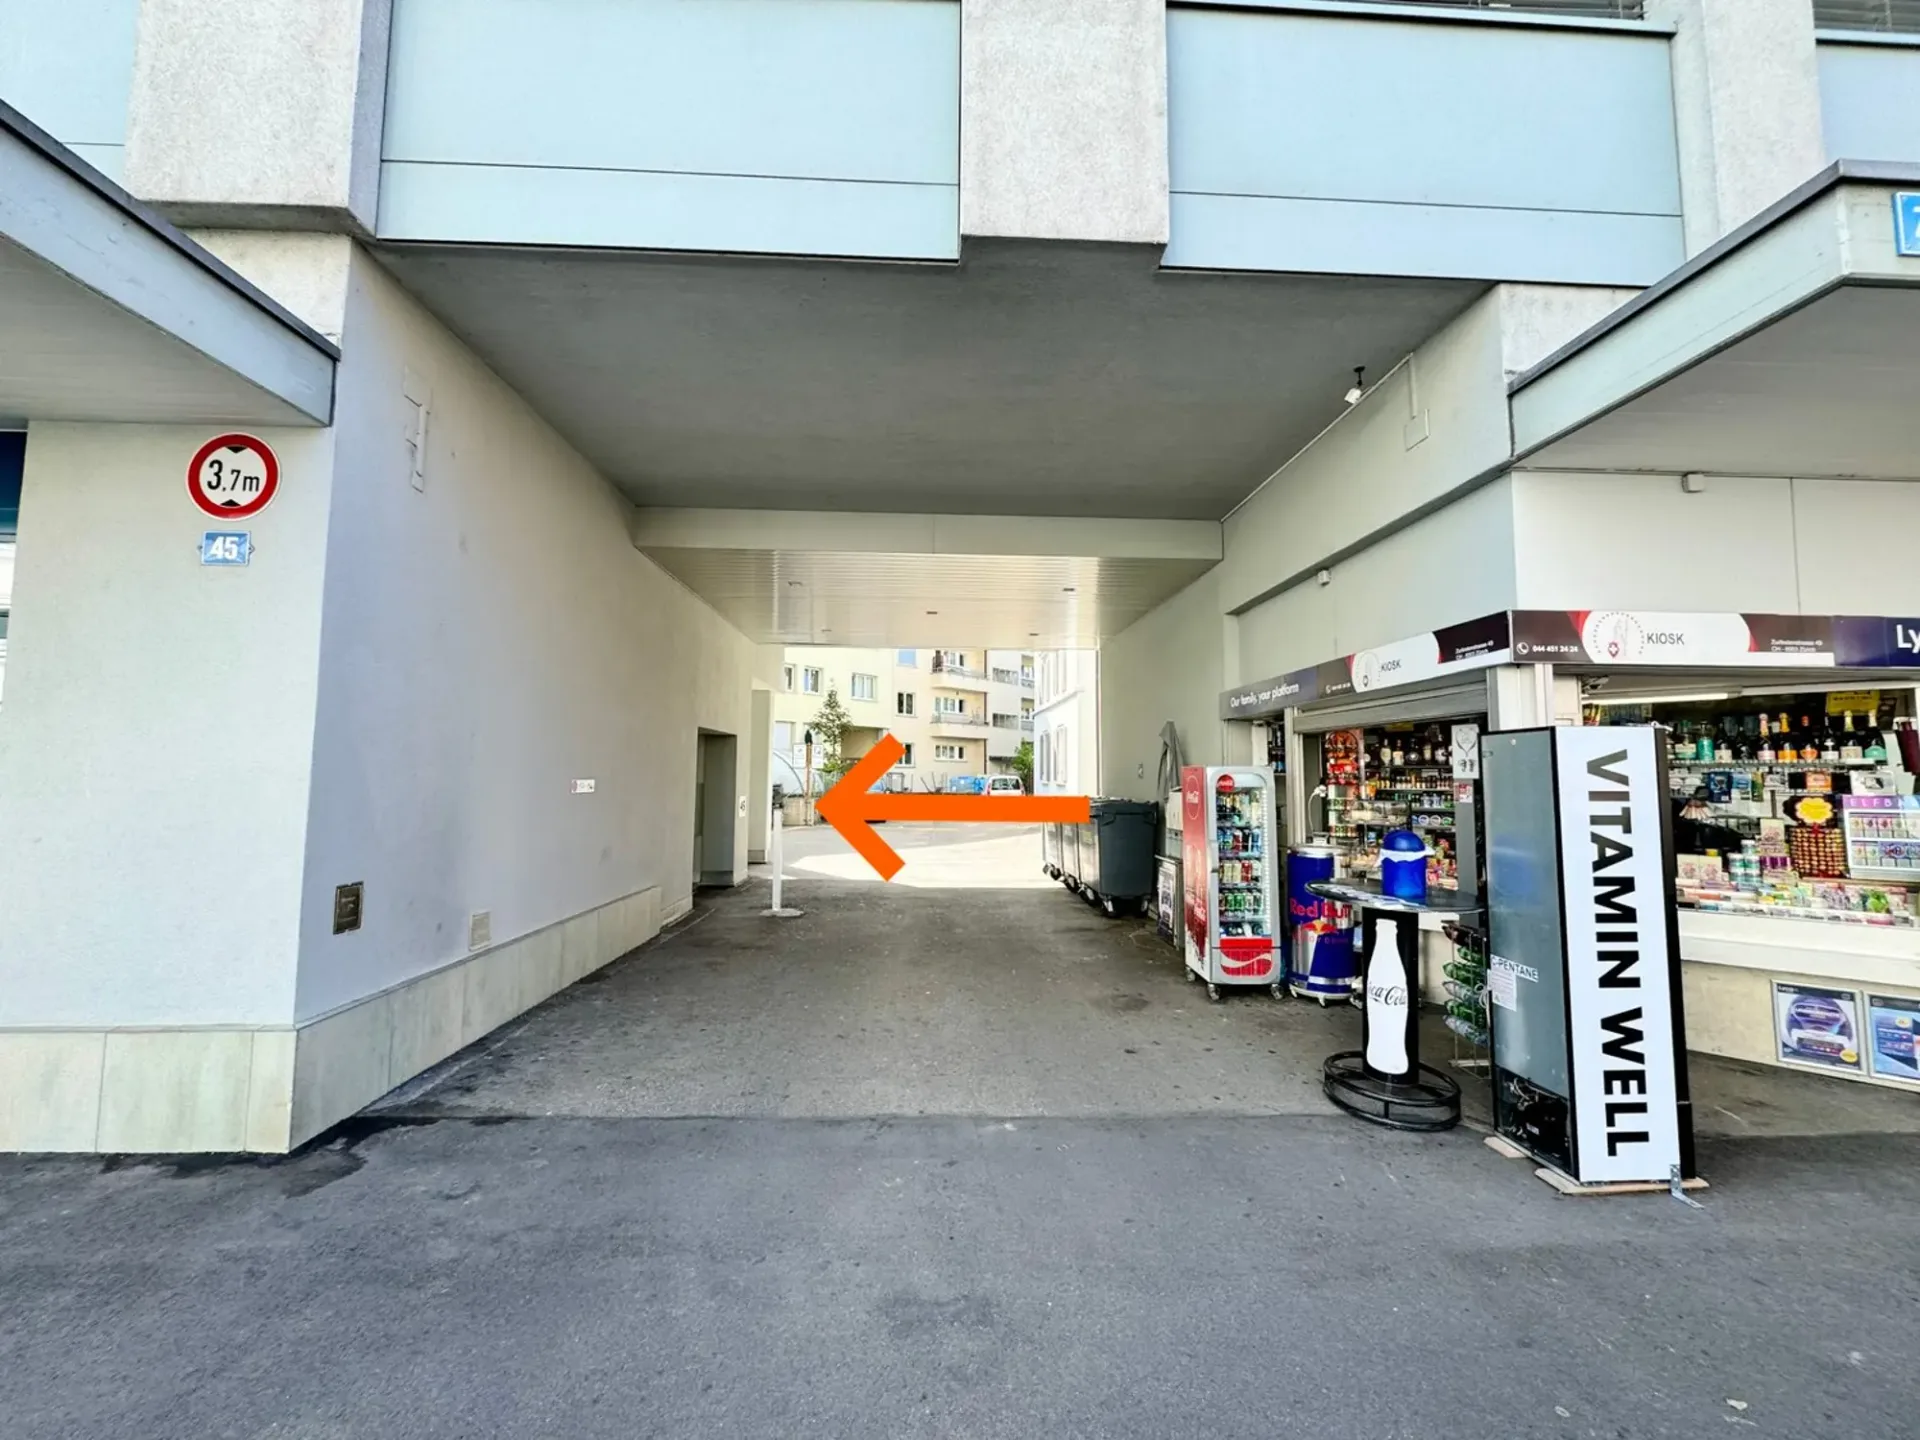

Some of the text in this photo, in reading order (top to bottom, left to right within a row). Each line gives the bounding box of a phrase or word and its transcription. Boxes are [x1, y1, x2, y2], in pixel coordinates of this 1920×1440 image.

[209, 536, 239, 560] 45
[1646, 632, 1685, 646] KIOSK
[1380, 659, 1402, 672] KIOSK
[1272, 682, 1299, 702] platform
[1289, 898, 1319, 918] Red
[1587, 749, 1650, 1157] VITAMIN WELL
